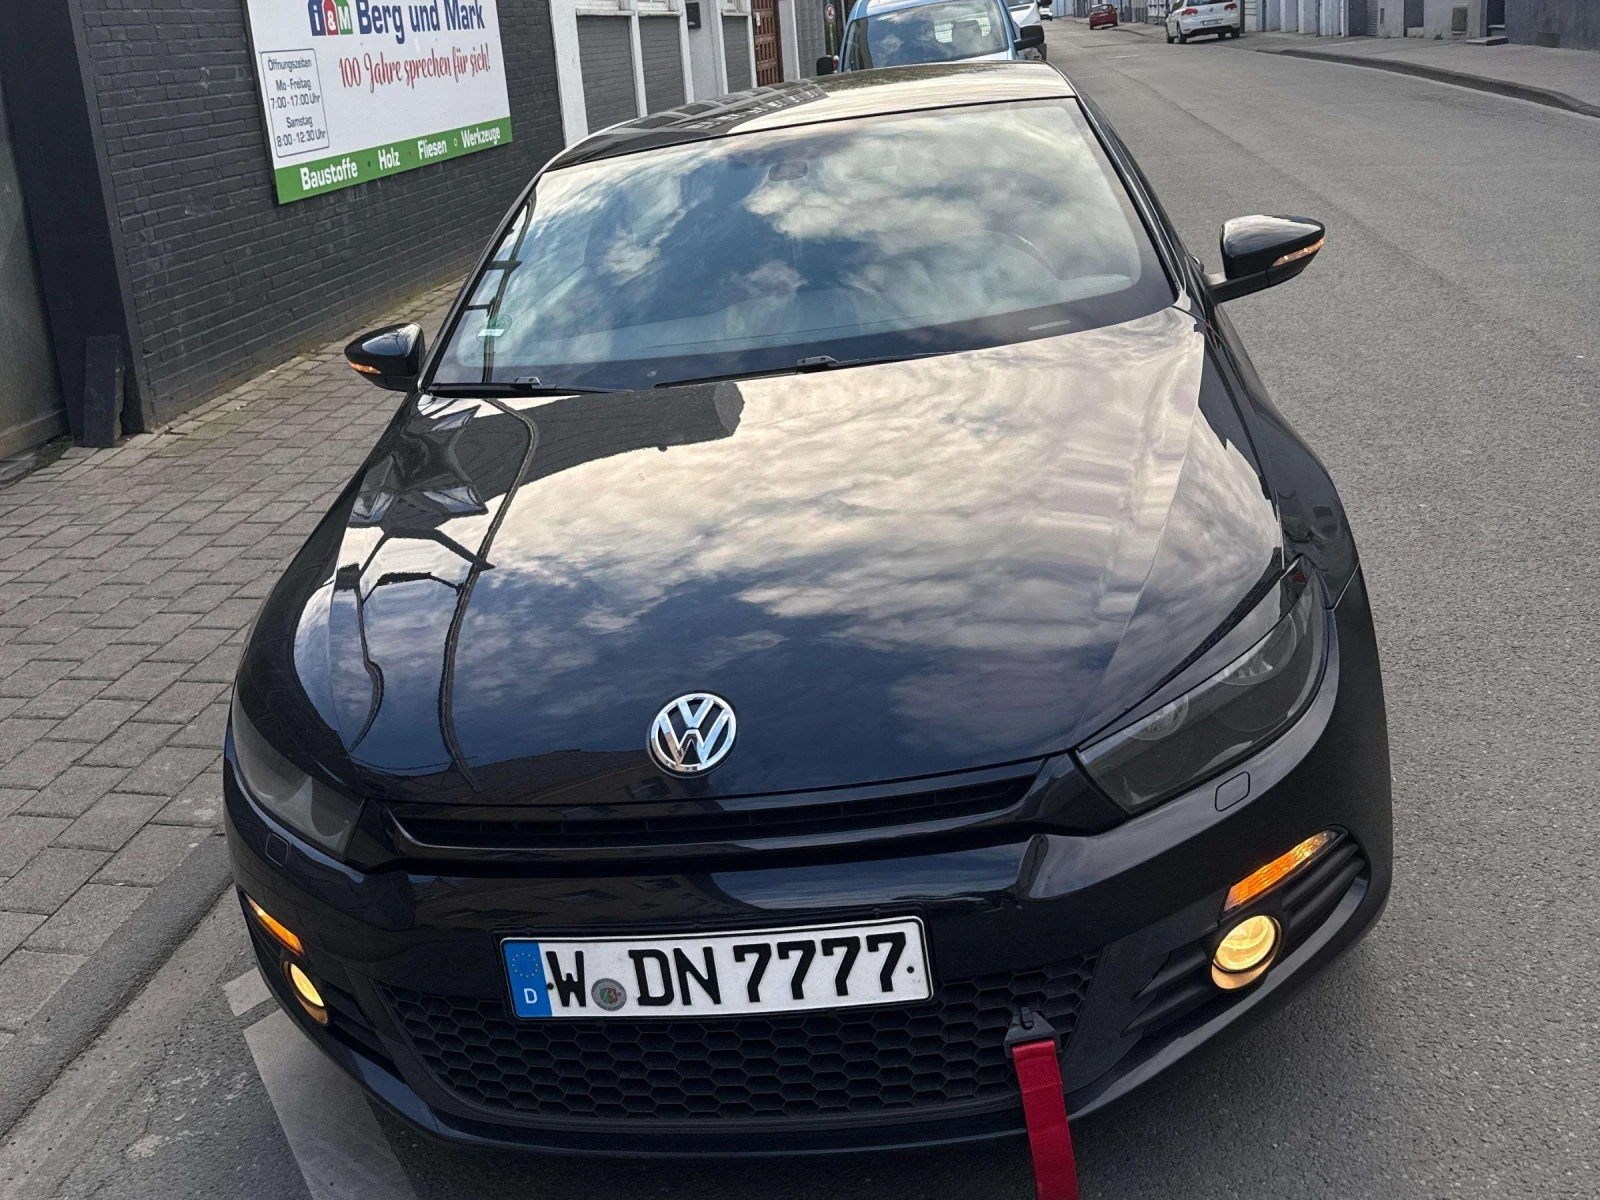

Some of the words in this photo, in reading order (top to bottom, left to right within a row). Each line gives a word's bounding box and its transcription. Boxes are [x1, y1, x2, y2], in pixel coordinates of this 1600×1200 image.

[356, 0, 405, 44] Berg
[408, 0, 441, 32] und
[443, 0, 485, 31] Mark
[267, 56, 312, 72] Öffnungszeiten
[339, 57, 361, 88] 100
[364, 52, 403, 94] Jahre
[404, 47, 452, 90] sprechen
[452, 45, 468, 83] für
[469, 42, 491, 77] sich!
[286, 115, 314, 129] Samstag
[299, 156, 359, 191] Baustoffe
[377, 146, 401, 171] Holz
[417, 138, 448, 161] Fliesen
[460, 126, 501, 150] Werkzeuge
[523, 987, 539, 1005] D
[545, 950, 588, 1008] W
[627, 945, 723, 1007] DN
[732, 931, 907, 1004] 7777
